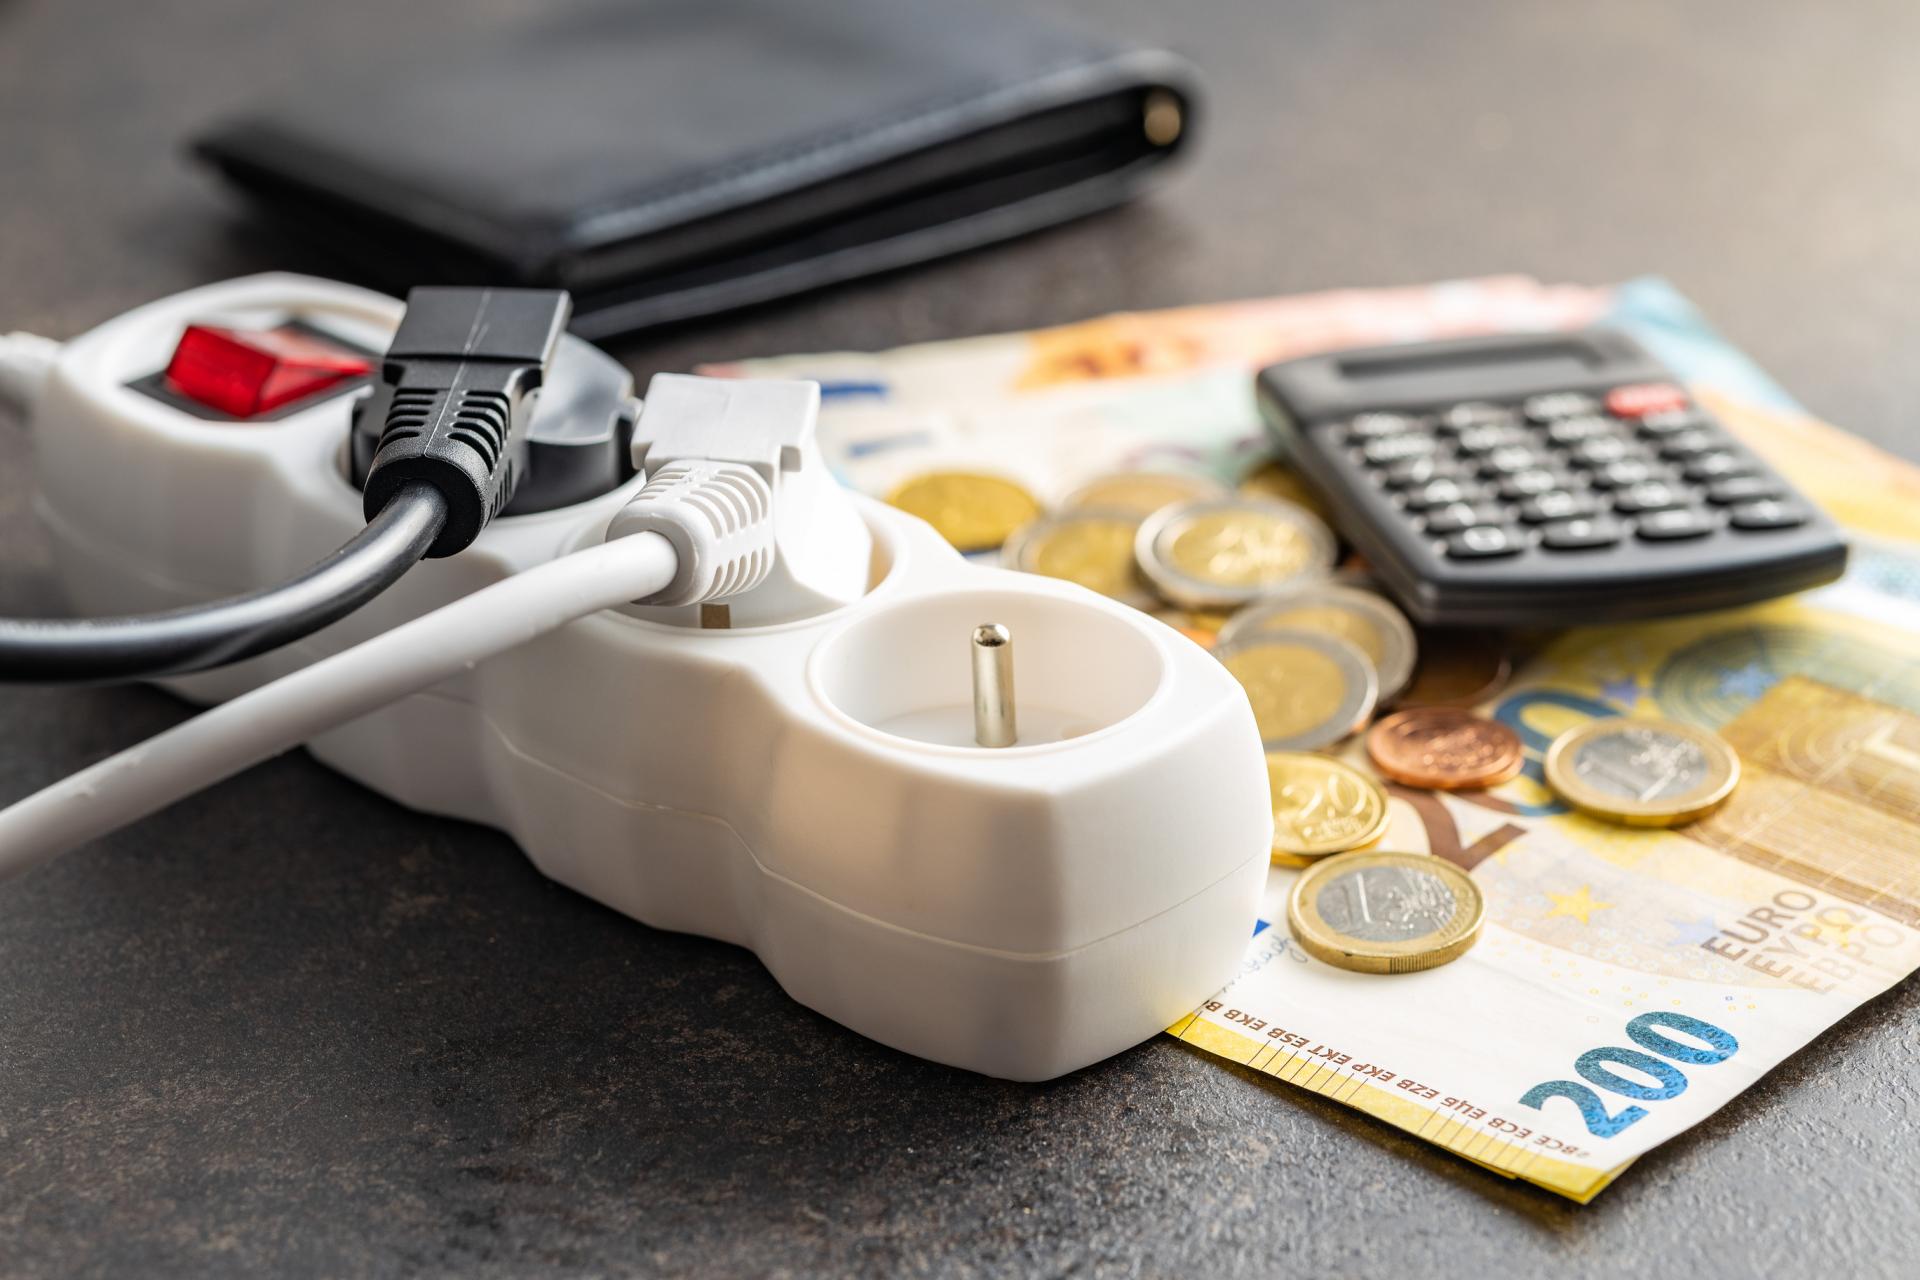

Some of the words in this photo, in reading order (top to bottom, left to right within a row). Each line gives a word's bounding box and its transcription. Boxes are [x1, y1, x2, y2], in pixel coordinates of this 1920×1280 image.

[1700, 890, 1817, 962] EURO
[1223, 1008, 1268, 1032] EKB
[1267, 1027, 1311, 1049] ESB
[1351, 1063, 1397, 1082] EKP
[1518, 1011, 1739, 1139] 200
[1396, 1079, 1440, 1100] EZB
[1488, 1117, 1533, 1139] ECB
